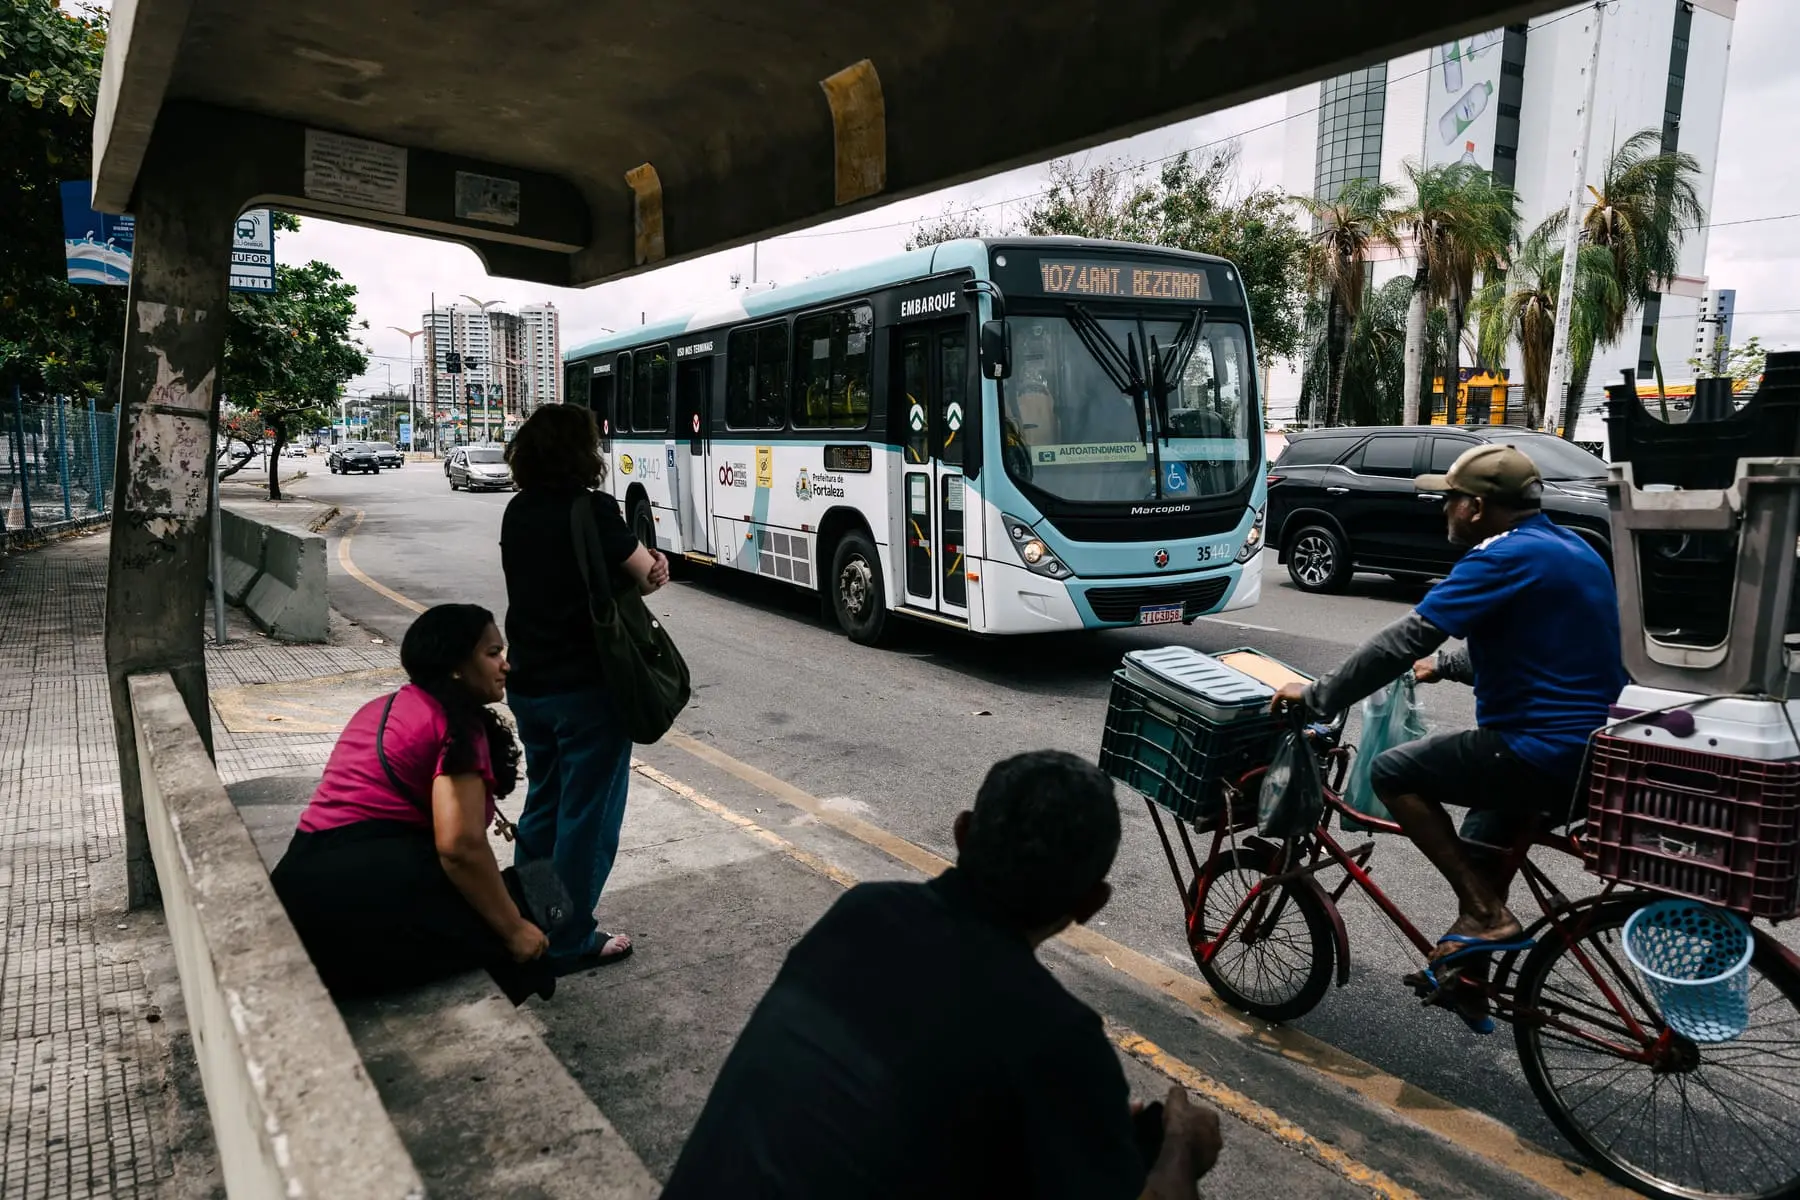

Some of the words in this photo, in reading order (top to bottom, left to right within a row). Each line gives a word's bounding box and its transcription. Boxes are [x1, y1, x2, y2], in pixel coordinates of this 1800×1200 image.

[1133, 270, 1200, 299] BEZERRA
[901, 291, 956, 317] EMBARQUE
[1059, 445, 1136, 455] AUTOATENDIMENTO
[812, 473, 836, 482] Prefeitura
[837, 474, 844, 483] de
[812, 484, 844, 497] Fortaleza
[1131, 504, 1190, 514] Marcopolo
[1197, 543, 1230, 561] 35442
